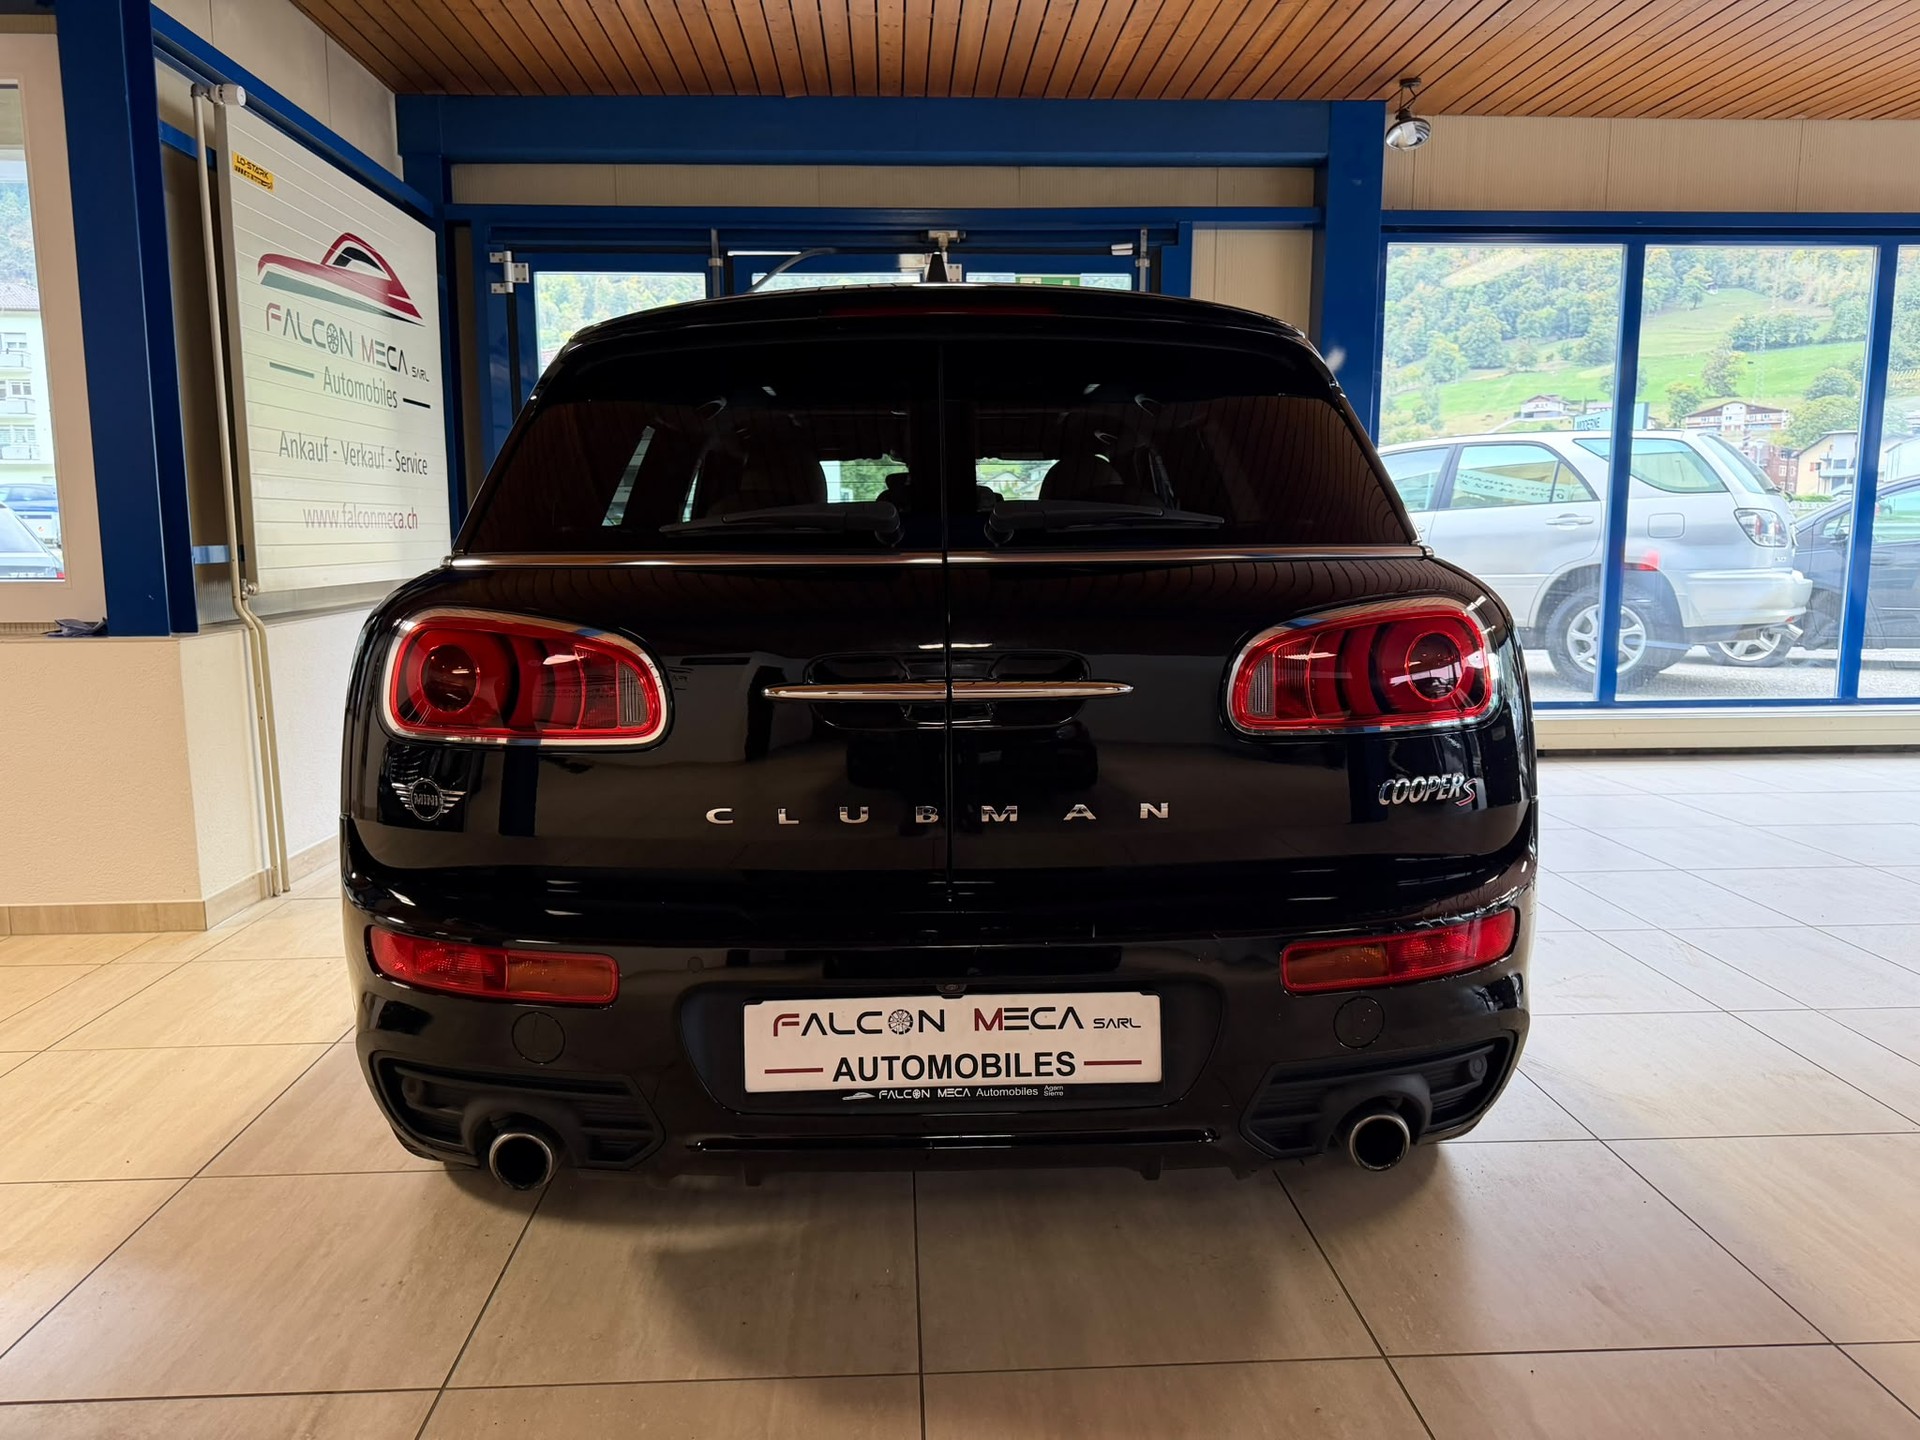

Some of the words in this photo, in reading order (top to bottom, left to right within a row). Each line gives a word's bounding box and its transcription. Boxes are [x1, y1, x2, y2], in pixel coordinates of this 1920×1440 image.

[266, 302, 353, 358] FALCON
[361, 335, 408, 375] MECA
[411, 366, 430, 382] SARL
[323, 366, 398, 408] Automobiles
[278, 431, 329, 463] Ankauf
[340, 440, 385, 469] Verkauf
[395, 450, 428, 475] Service
[302, 502, 418, 529] www.falconmeca.ch
[413, 793, 438, 807] MINI
[705, 801, 1170, 825] CLUBMAN
[773, 1008, 945, 1037] FALCON
[974, 1006, 1084, 1031] MECA
[1093, 1018, 1141, 1029] SARL
[832, 1051, 1076, 1082] AUTOMOBILES
[878, 1088, 930, 1100] FALCON
[938, 1087, 971, 1098] MECA
[976, 1086, 1039, 1097] Automobiles
